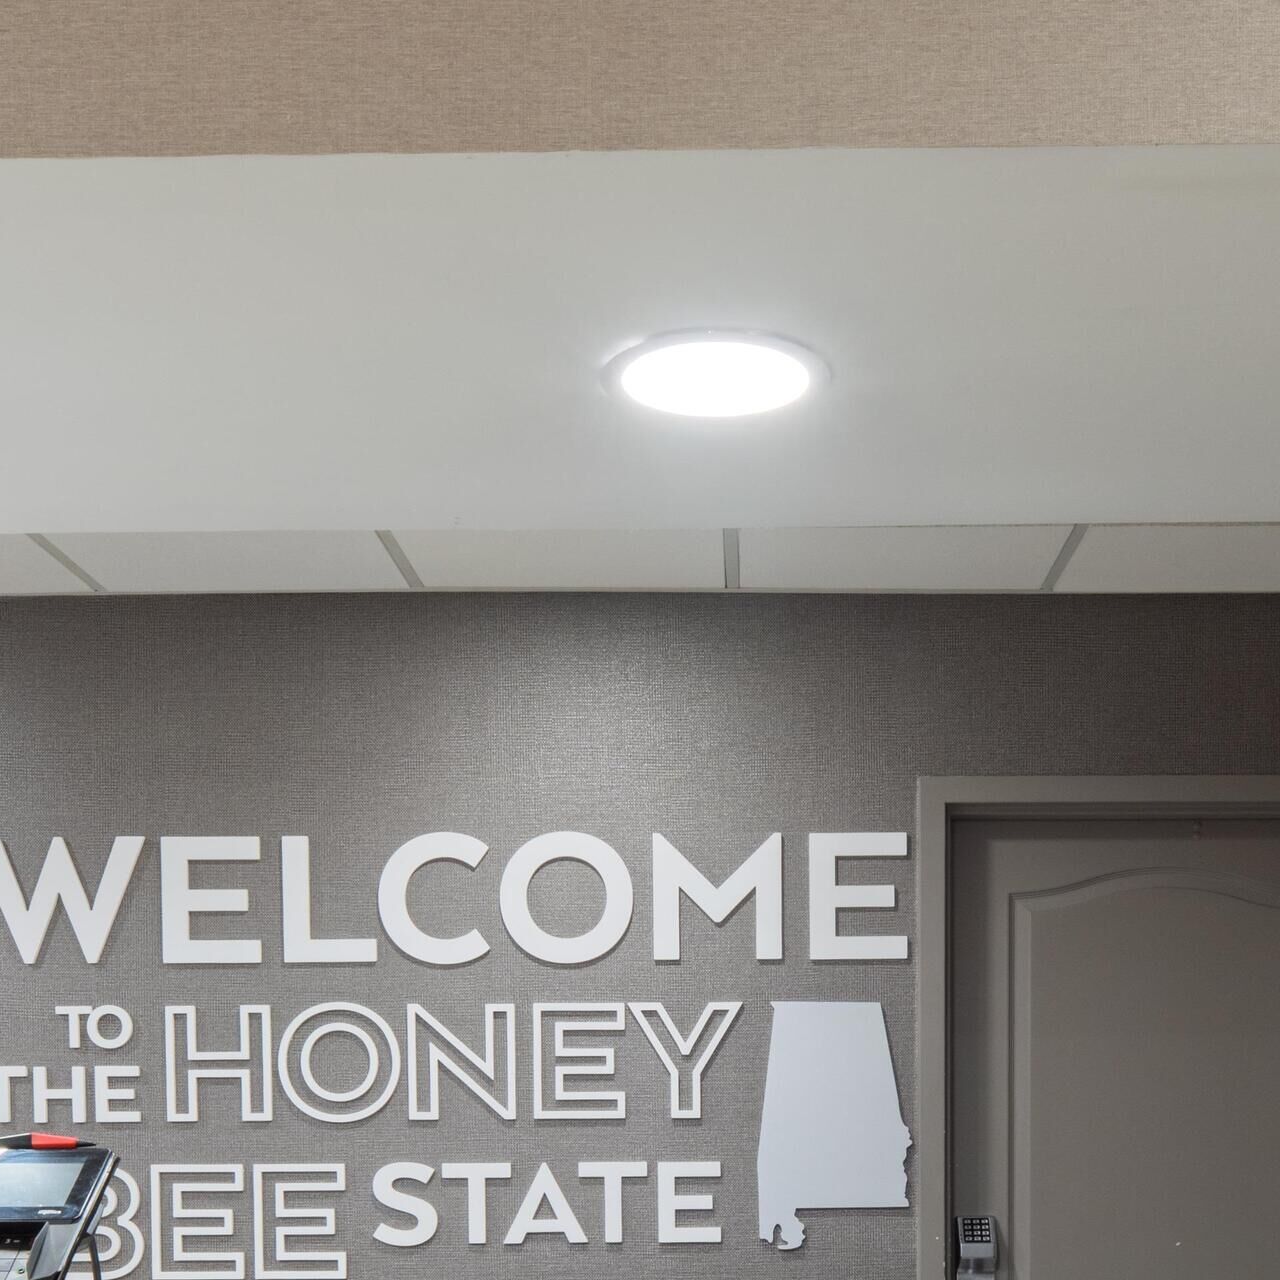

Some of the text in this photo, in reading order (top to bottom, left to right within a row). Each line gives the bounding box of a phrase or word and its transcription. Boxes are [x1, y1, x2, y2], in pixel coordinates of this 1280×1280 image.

[55, 1004, 134, 1051] TO
[166, 1002, 744, 1124] HONEY
[372, 1161, 722, 1248] STATE
